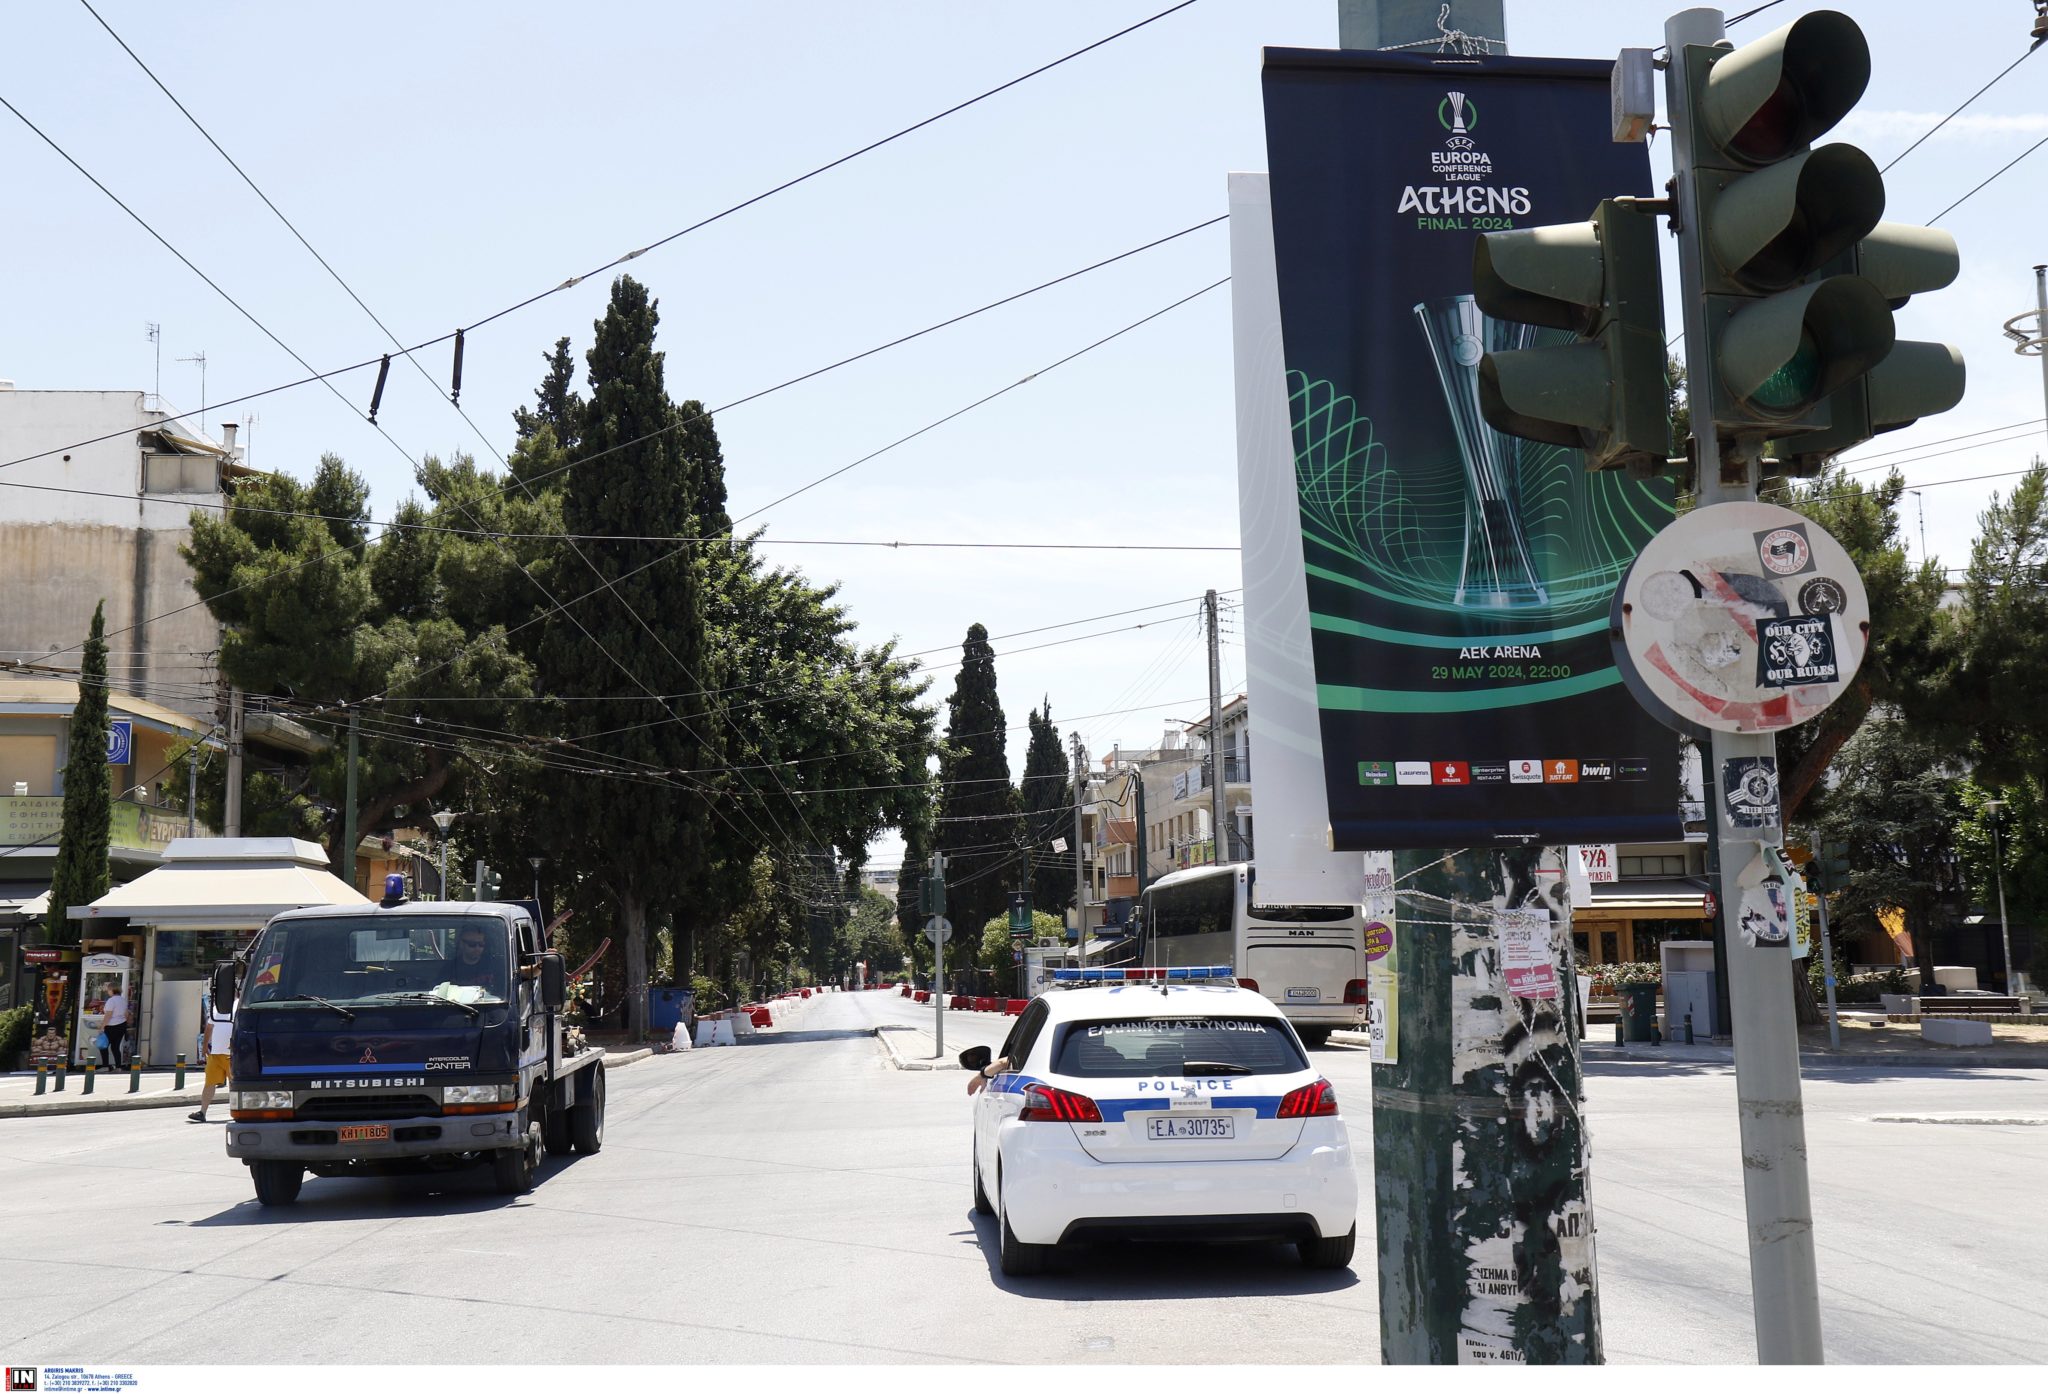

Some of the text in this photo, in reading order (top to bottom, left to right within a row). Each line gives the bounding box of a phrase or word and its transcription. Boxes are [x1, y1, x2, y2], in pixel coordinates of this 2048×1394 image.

[1447, 138, 1473, 149] UEFA
[1431, 152, 1491, 164] EUROPA
[1432, 165, 1492, 173] CONFERENCE
[1397, 185, 1531, 215] ATHENS
[1417, 217, 1513, 230] FINAL 2024
[1765, 622, 1825, 637] OUR CITY
[1460, 646, 1541, 659] AEK ARENA
[1431, 665, 1571, 680] 29 MAY 2024, 22:00
[1767, 664, 1835, 680] OUR RULES
[1582, 763, 1610, 776] bwin
[1512, 773, 1541, 781] Swissquote
[1589, 871, 1612, 881] ΡΓΑΣΙΑ
[1088, 1020, 1266, 1037] ΕΛΛΗΝΙΚΗ ΑΣΤΥΝΟΜΙΑ
[425, 1061, 470, 1070] CANTER
[310, 1077, 425, 1089] MITSUBISHI
[1138, 1079, 1233, 1091] POLICE
[1187, 1119, 1226, 1135] 30735
[1474, 1282, 1486, 1294] ΑΙ
